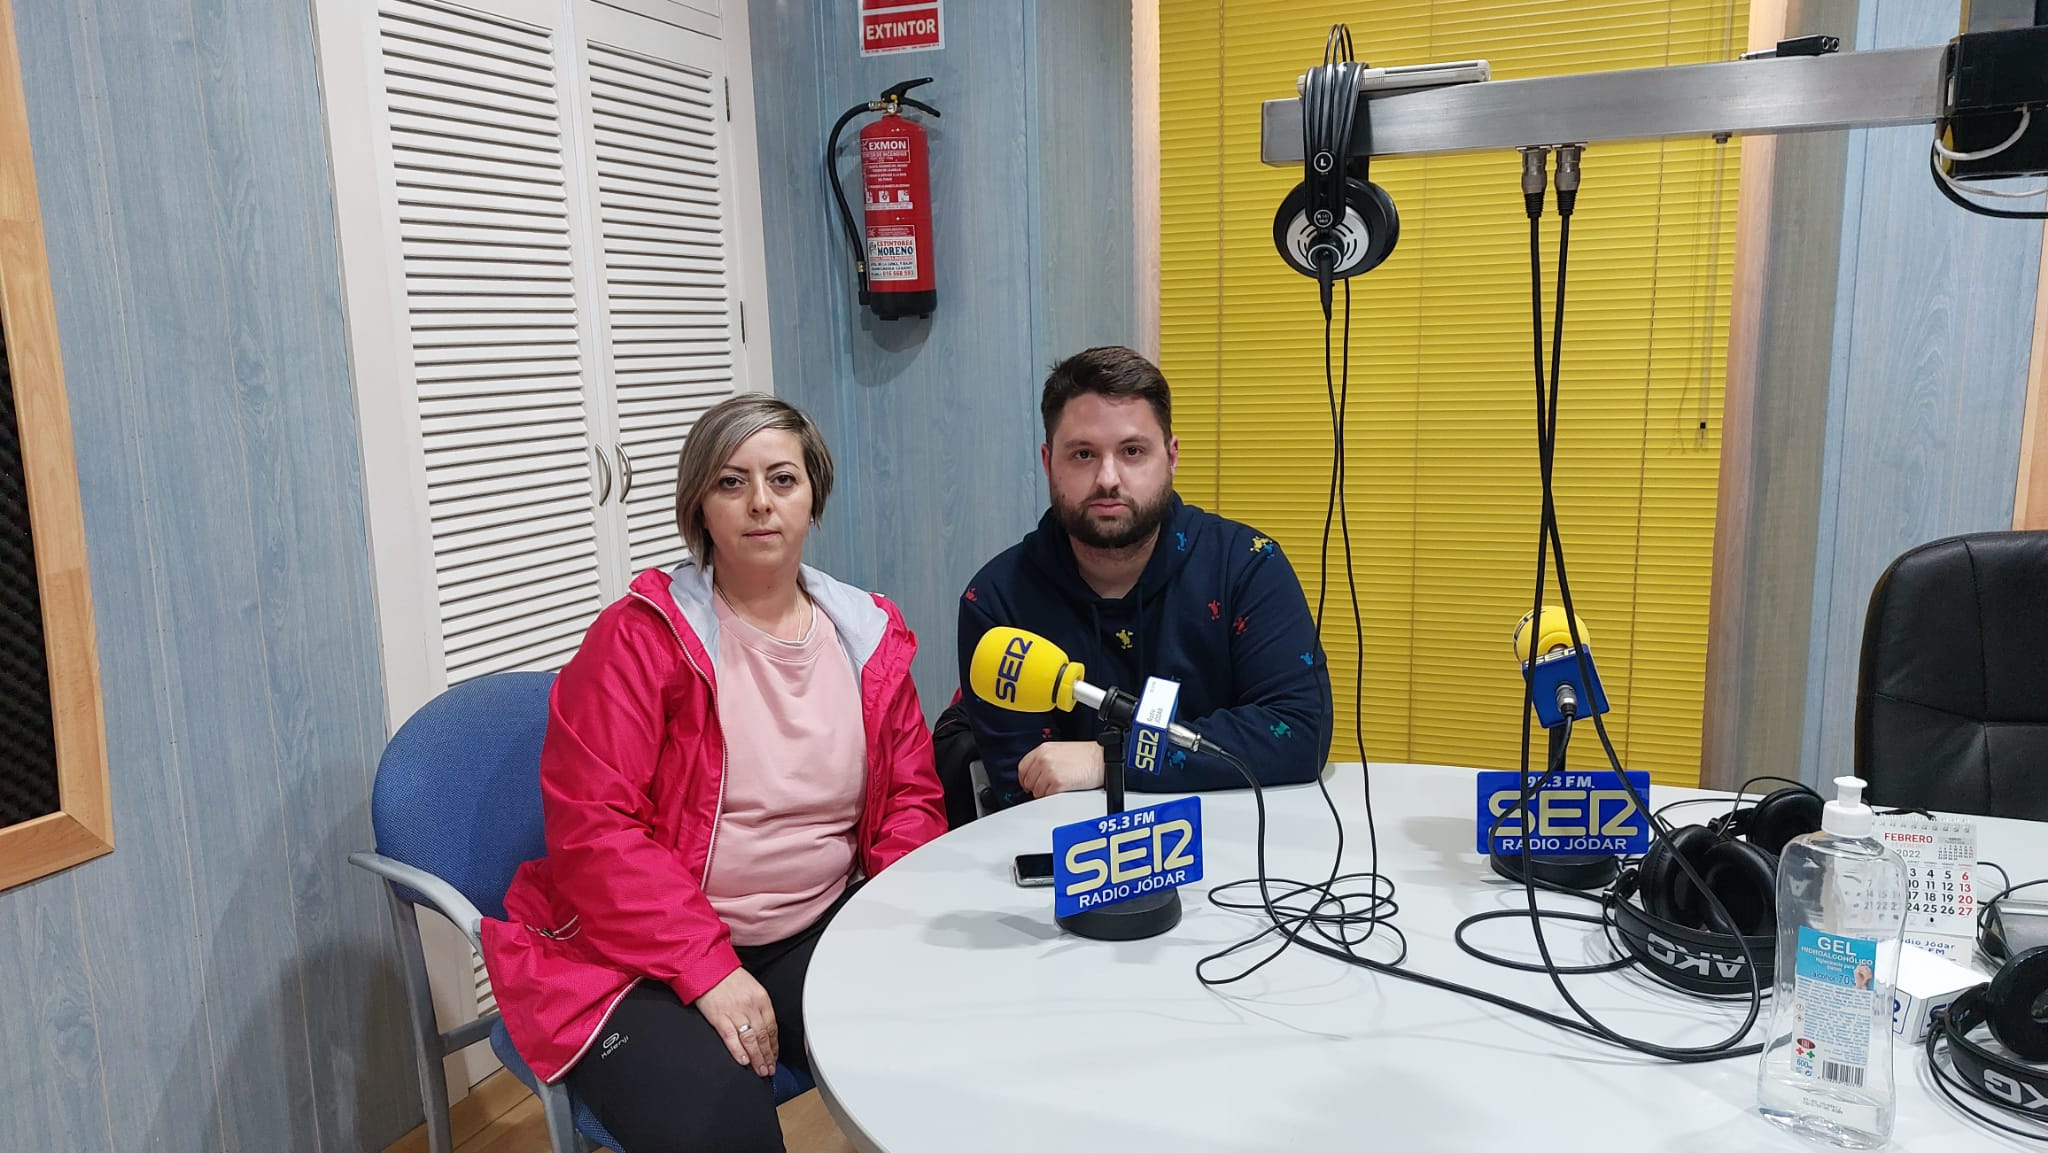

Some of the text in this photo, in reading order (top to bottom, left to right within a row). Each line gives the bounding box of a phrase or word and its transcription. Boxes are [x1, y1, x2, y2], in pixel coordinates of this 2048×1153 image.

[866, 19, 936, 40] EXTINTOR
[868, 140, 907, 150] EXMON
[877, 246, 914, 256] MORENO
[995, 636, 1033, 704] SER
[1134, 729, 1160, 772] SER
[1527, 776, 1562, 788] 9.3
[1488, 789, 1639, 837] SER
[1098, 810, 1155, 834] 95.3 FM
[1502, 836, 1627, 850] RADIO JÓDAR
[1884, 832, 1933, 844] FEBRERO
[1065, 819, 1195, 896] SER
[1896, 849, 1921, 859] 2022
[1909, 868, 1969, 881] 3 4 5 6
[1079, 870, 1186, 908] RADIO JÓDAR
[1908, 879, 1920, 889] 10
[1926, 881, 1936, 890] 11
[1942, 882, 1954, 891] 12
[1959, 883, 1972, 893] 13
[1908, 891, 1919, 900] 17
[1924, 892, 1937, 902] 18
[1941, 893, 1954, 903] 19
[1958, 895, 1973, 905] 20
[1907, 903, 1920, 912] 24
[1922, 903, 1938, 913] 25
[1940, 905, 1955, 915] 26
[1958, 907, 1973, 916] 27
[1817, 936, 1857, 957] GEL
[1647, 932, 1747, 978] AKG
